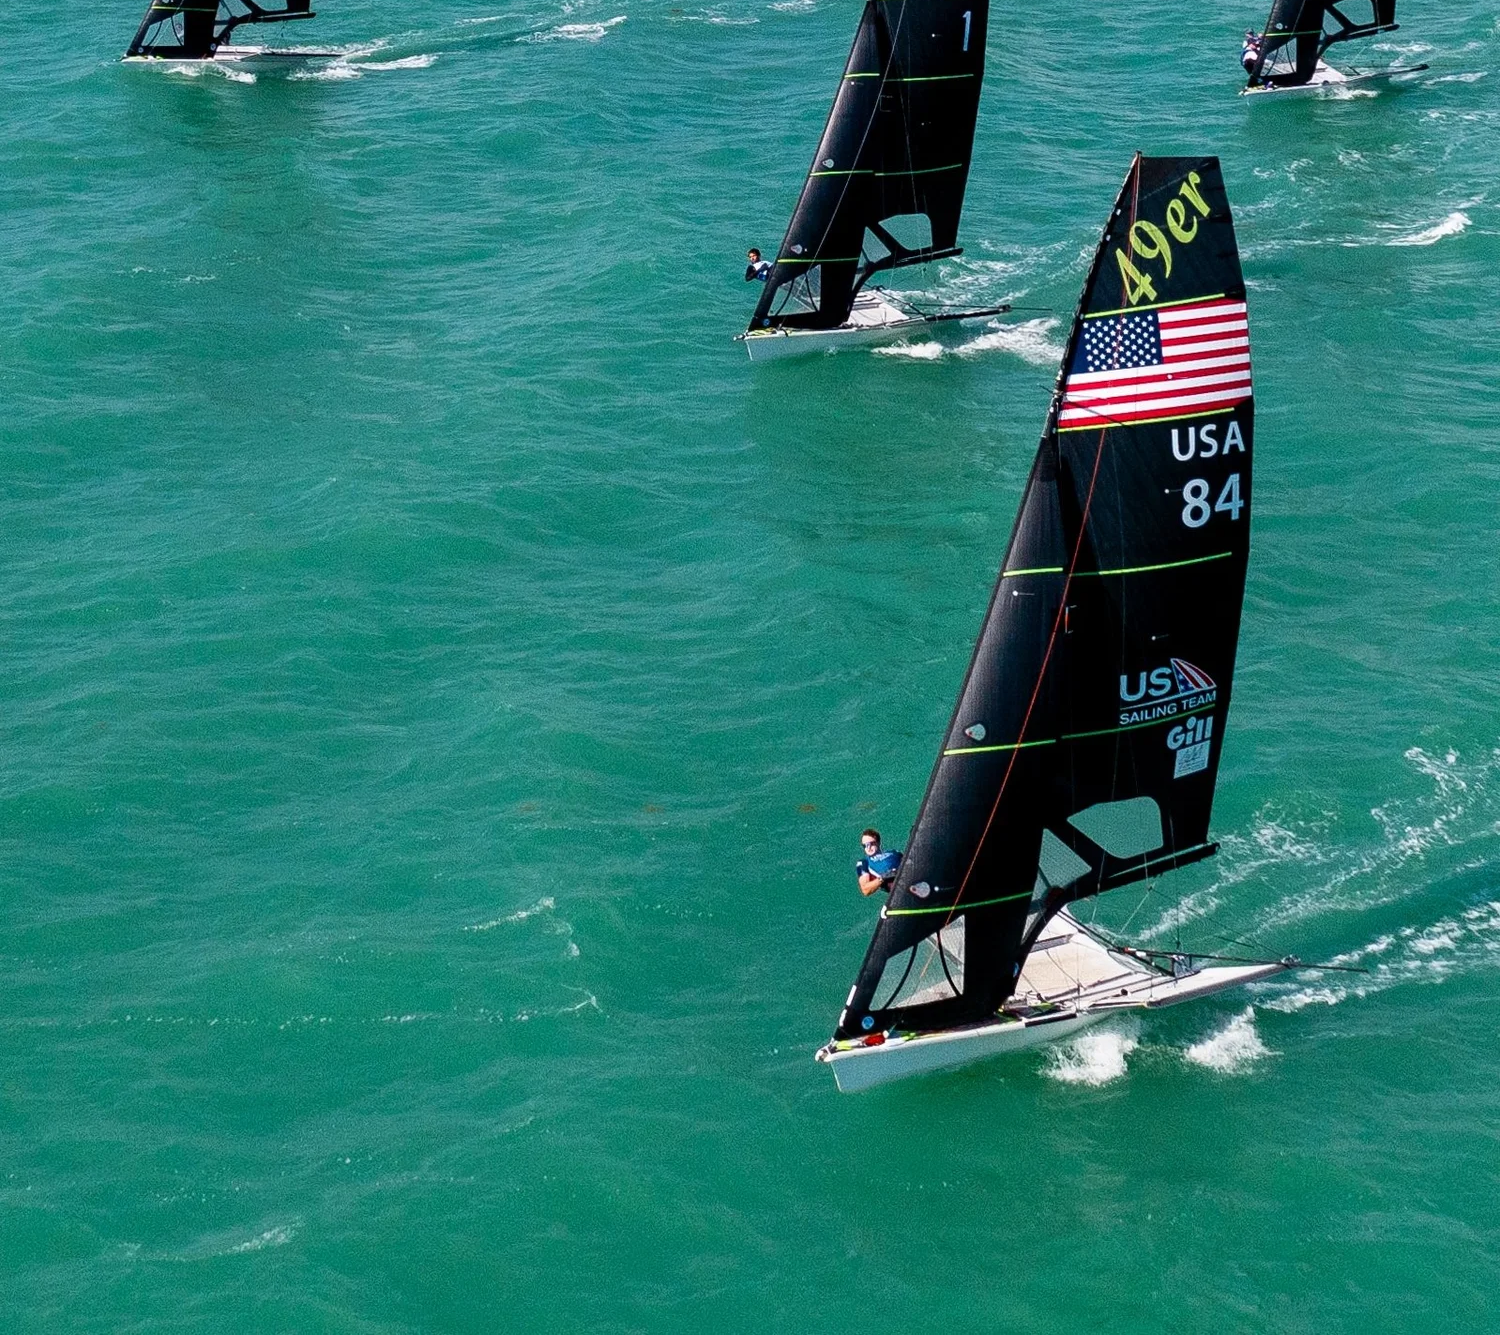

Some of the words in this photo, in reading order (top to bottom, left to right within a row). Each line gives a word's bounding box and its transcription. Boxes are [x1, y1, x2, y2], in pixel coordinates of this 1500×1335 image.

[962, 11, 971, 51] 1
[1115, 170, 1211, 306] 49er
[1171, 420, 1245, 461] USA
[1181, 473, 1244, 528] 84
[1119, 667, 1171, 701] US
[1119, 703, 1177, 725] SAILING
[1182, 691, 1216, 711] TEAM
[1167, 716, 1212, 750] Gill
